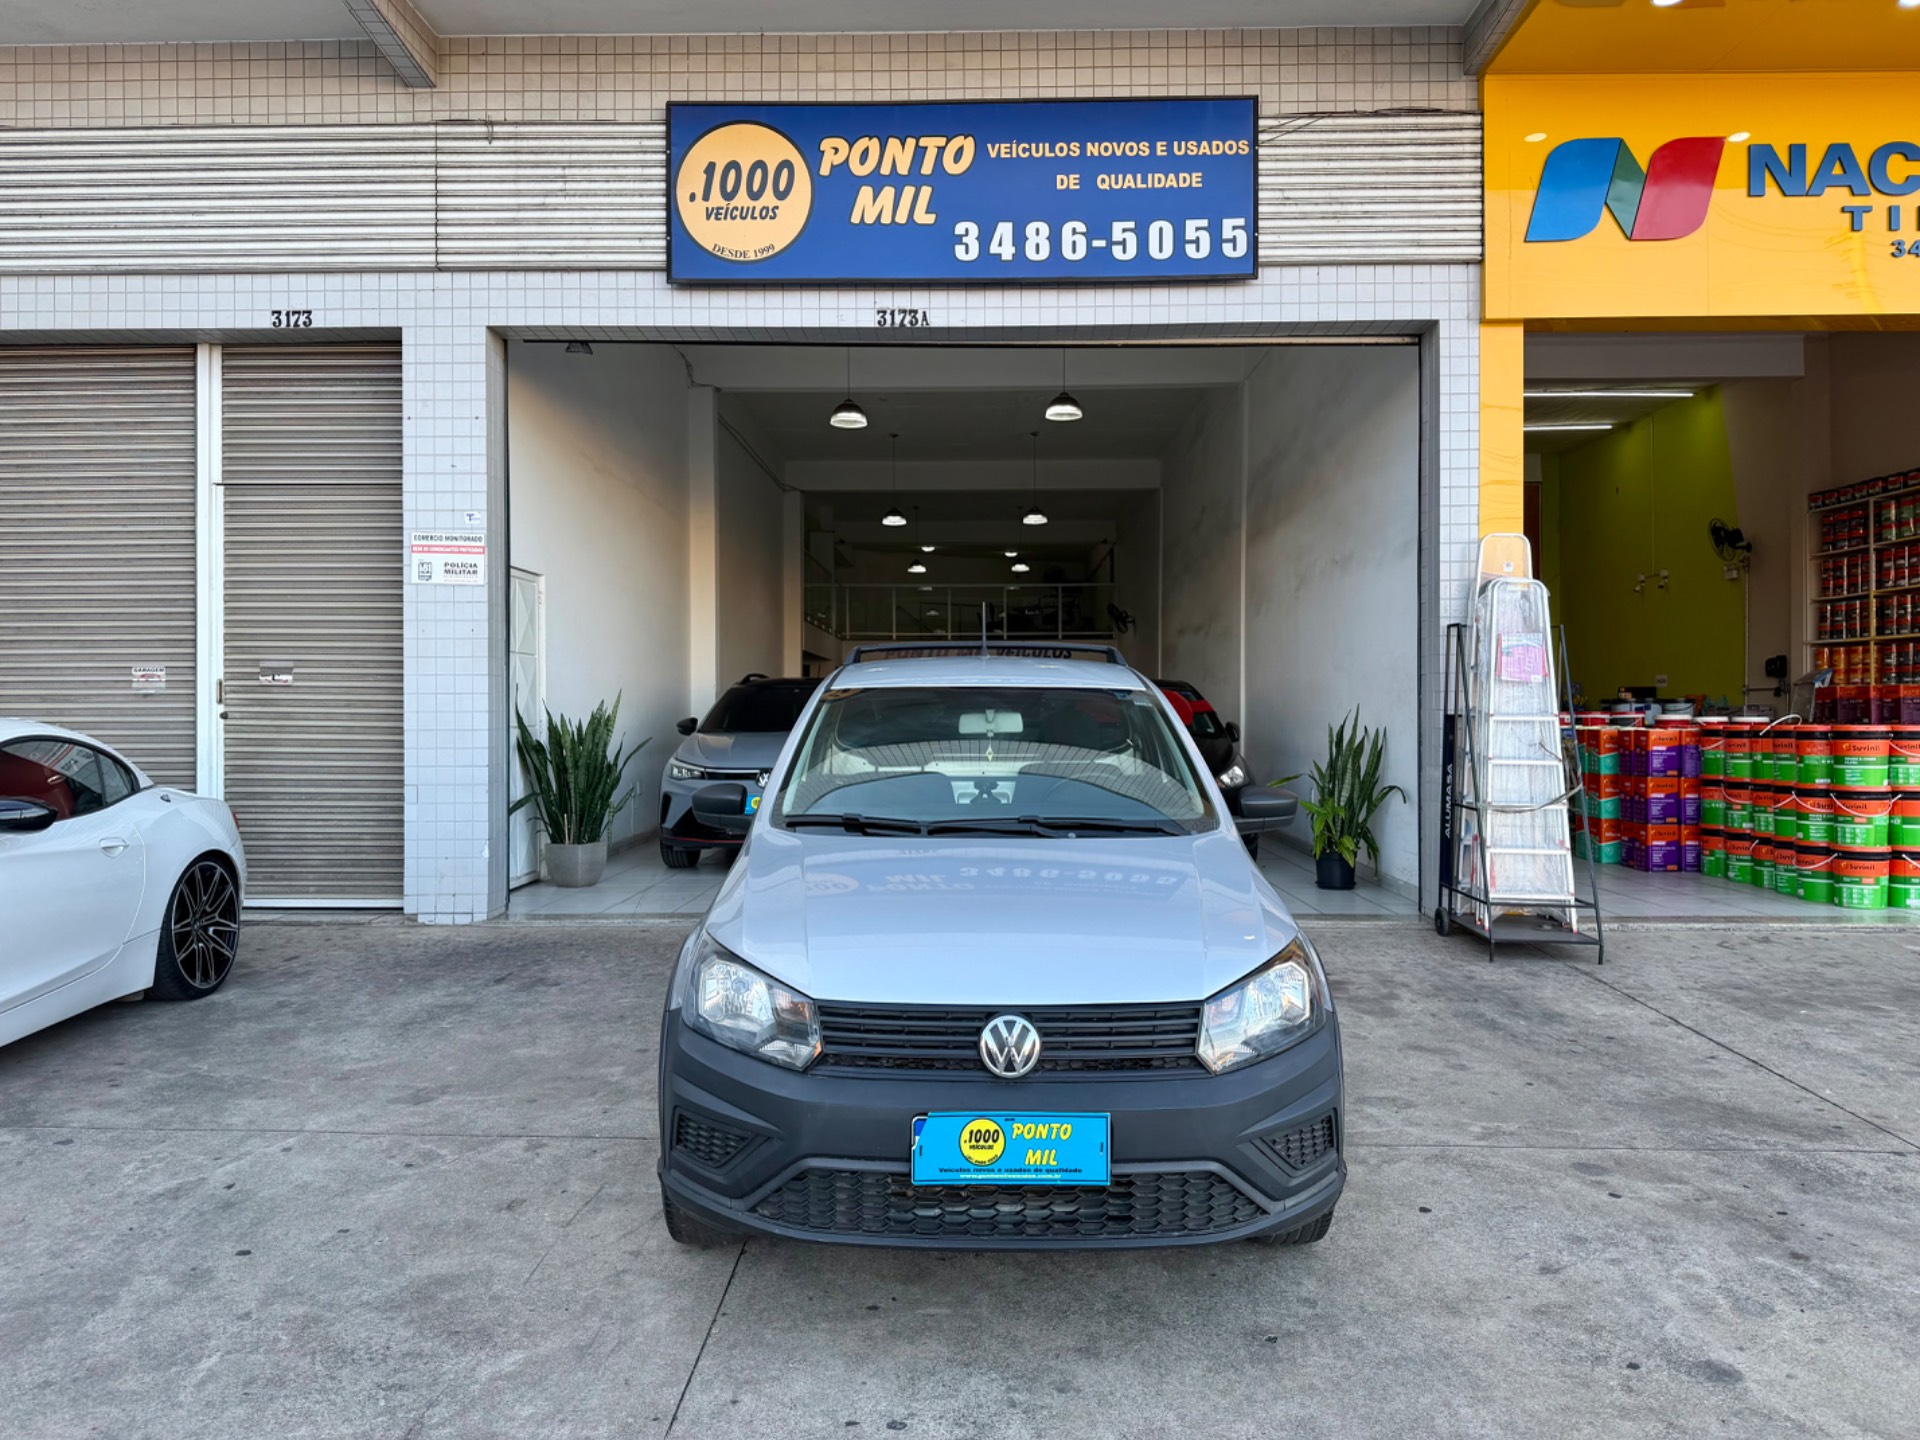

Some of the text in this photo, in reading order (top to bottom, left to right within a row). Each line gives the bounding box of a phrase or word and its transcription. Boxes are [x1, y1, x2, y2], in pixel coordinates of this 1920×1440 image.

[818, 136, 975, 177] PONTO
[987, 140, 1250, 158] VEÍCULOS NOVOS E USADOS
[689, 159, 796, 202] .1000
[1056, 172, 1203, 190] DE QUALIDADE
[705, 203, 780, 221] VEÍCULOS
[850, 184, 937, 226] MIL
[1841, 205, 1920, 232] TI
[954, 217, 1249, 261] 3486-5055
[712, 243, 776, 259] DESDE 1999
[271, 310, 313, 328] 3173
[1444, 763, 1453, 839] ALUMASA
[1011, 1123, 1072, 1140] PONTO
[1025, 1149, 1058, 1166] MIL
